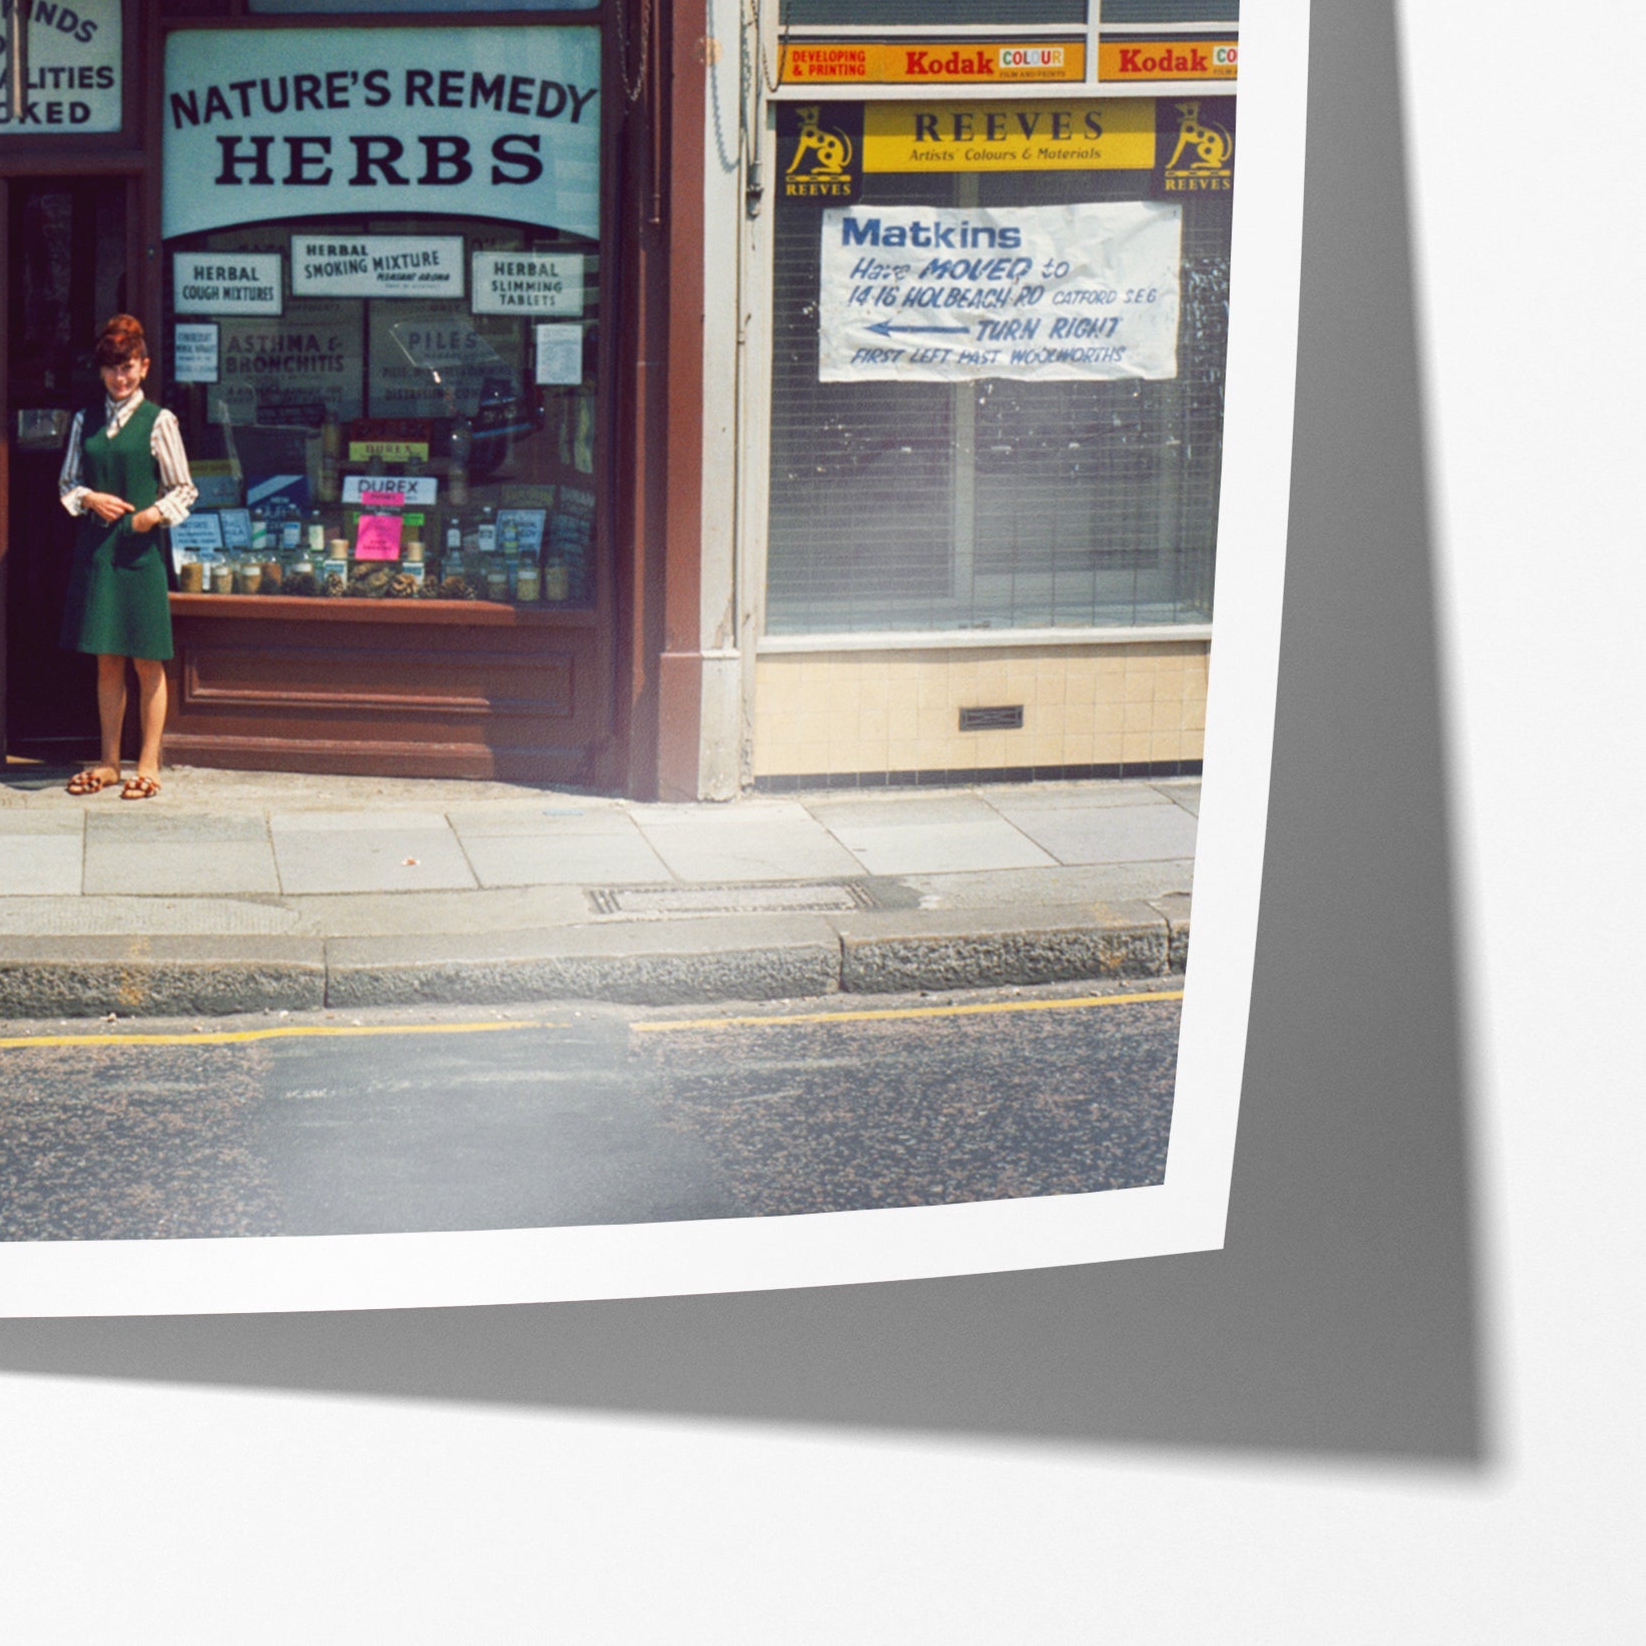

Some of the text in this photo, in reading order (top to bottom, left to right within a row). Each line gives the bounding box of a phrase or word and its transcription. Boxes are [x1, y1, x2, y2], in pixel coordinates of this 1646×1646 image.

[792, 50, 866, 63] DEVELOPING
[905, 50, 994, 75] Kodak
[1002, 50, 1063, 66] COLOUR
[1118, 48, 1208, 73] Kodak
[792, 65, 866, 76] & PRINTING
[169, 68, 599, 130] NATURE'S REMEDY
[912, 110, 1103, 143] REEVES
[214, 134, 544, 185] HERBS
[964, 148, 1017, 161] Colours
[1021, 148, 1035, 160] &
[1036, 147, 1102, 160] Materials
[785, 183, 852, 196] REEVES
[1164, 178, 1231, 191] REEVES
[841, 217, 1022, 249] Matkins
[306, 244, 369, 257] HERBAL
[194, 265, 259, 282] HERBAL
[304, 250, 440, 280] SMOKING MIXTURE
[494, 261, 559, 277] HERBAL
[849, 256, 1070, 282] Have MOVED to
[182, 285, 274, 302] COUGH MIXTURES
[491, 280, 562, 293] SLIMMING
[499, 293, 557, 306] TABLETS
[902, 286, 1014, 309] HOLBEACH
[1014, 285, 1046, 307] RD
[1051, 289, 1117, 305] CATFORD
[976, 317, 1123, 342] TURN RIGHT
[226, 334, 321, 353] ASTHMA
[408, 330, 478, 350] PILES
[225, 354, 345, 374] BRONCHITIS
[850, 345, 1126, 365] FIRST LEFT PAST WOOLWORTHS
[358, 479, 419, 494] DUREX
